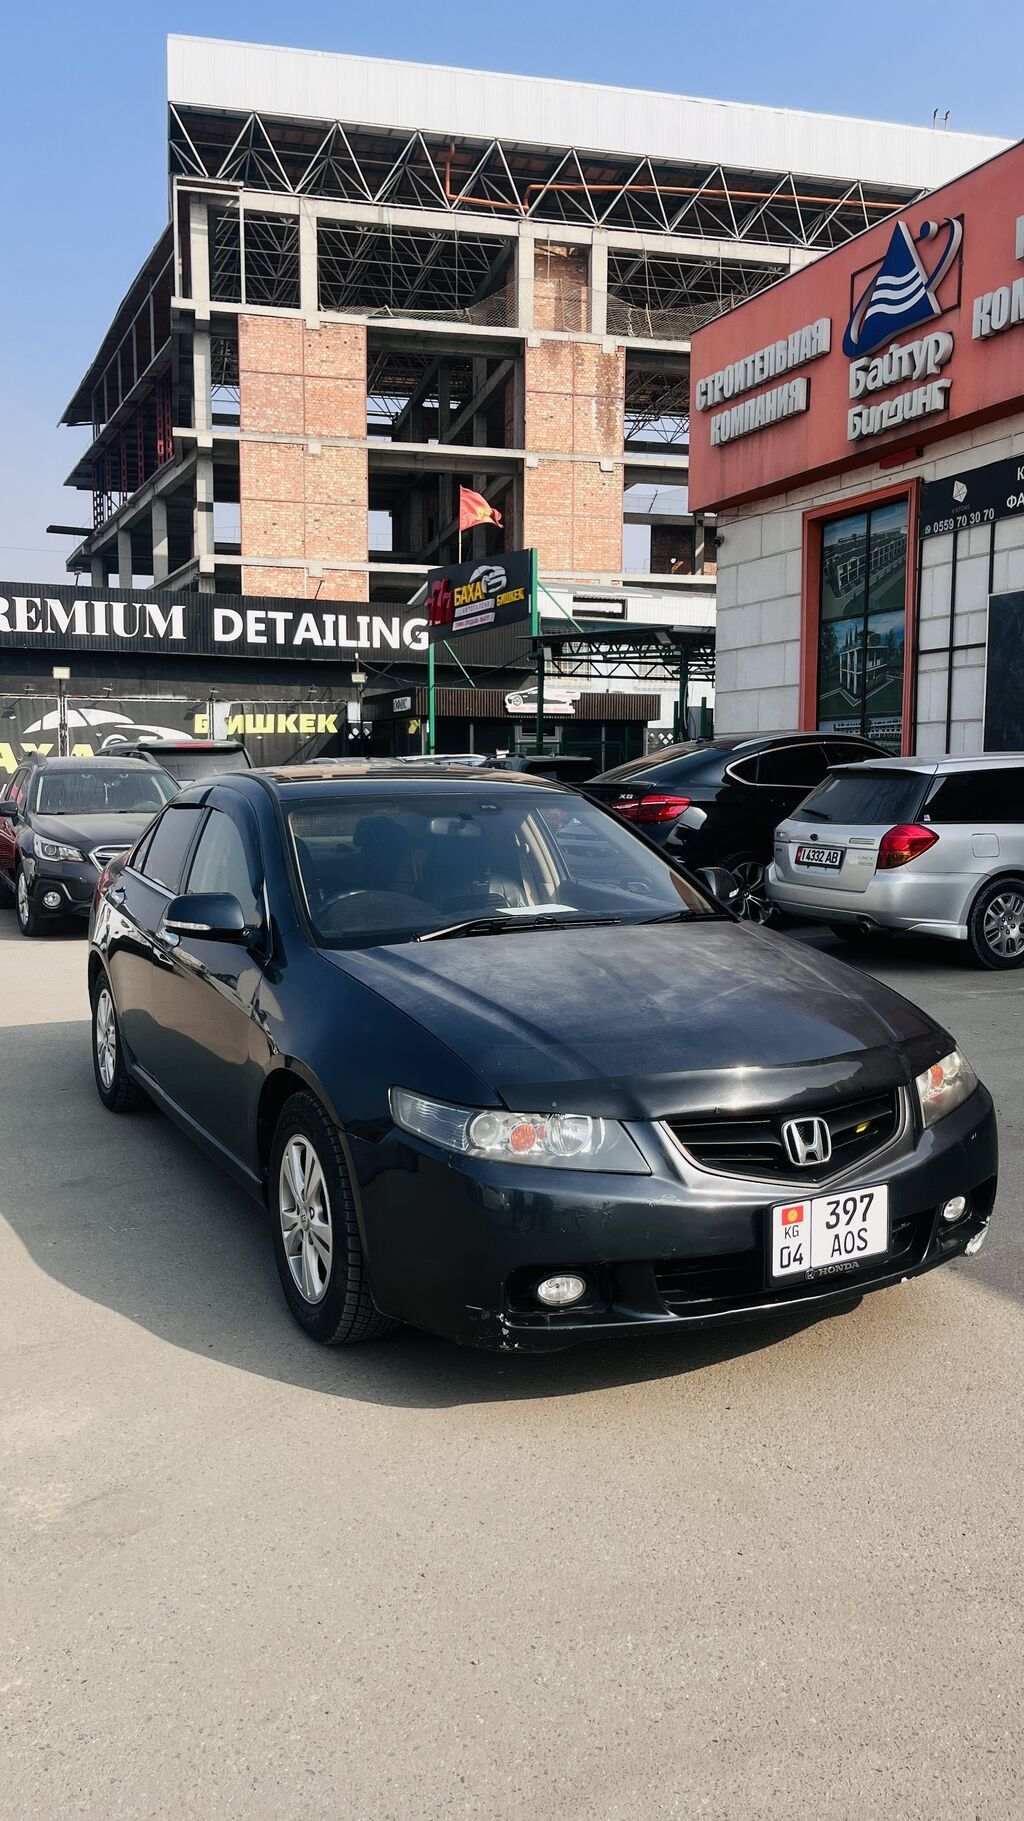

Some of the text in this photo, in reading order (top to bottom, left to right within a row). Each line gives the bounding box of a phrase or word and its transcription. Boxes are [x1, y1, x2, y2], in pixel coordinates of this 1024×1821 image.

[696, 317, 831, 411] СТРОИТЕЛЬНАЯ
[710, 377, 808, 447] КОМПАНИЯ
[933, 507, 995, 533] 0559 70 30 70
[454, 581, 483, 607] БАХА
[213, 608, 429, 650] DETAILING
[806, 850, 825, 862] 4332
[825, 851, 839, 863] AB
[825, 1193, 875, 1230] 397
[784, 1223, 799, 1239] KG
[779, 1242, 803, 1269] 04
[818, 1261, 860, 1276] HONDA
